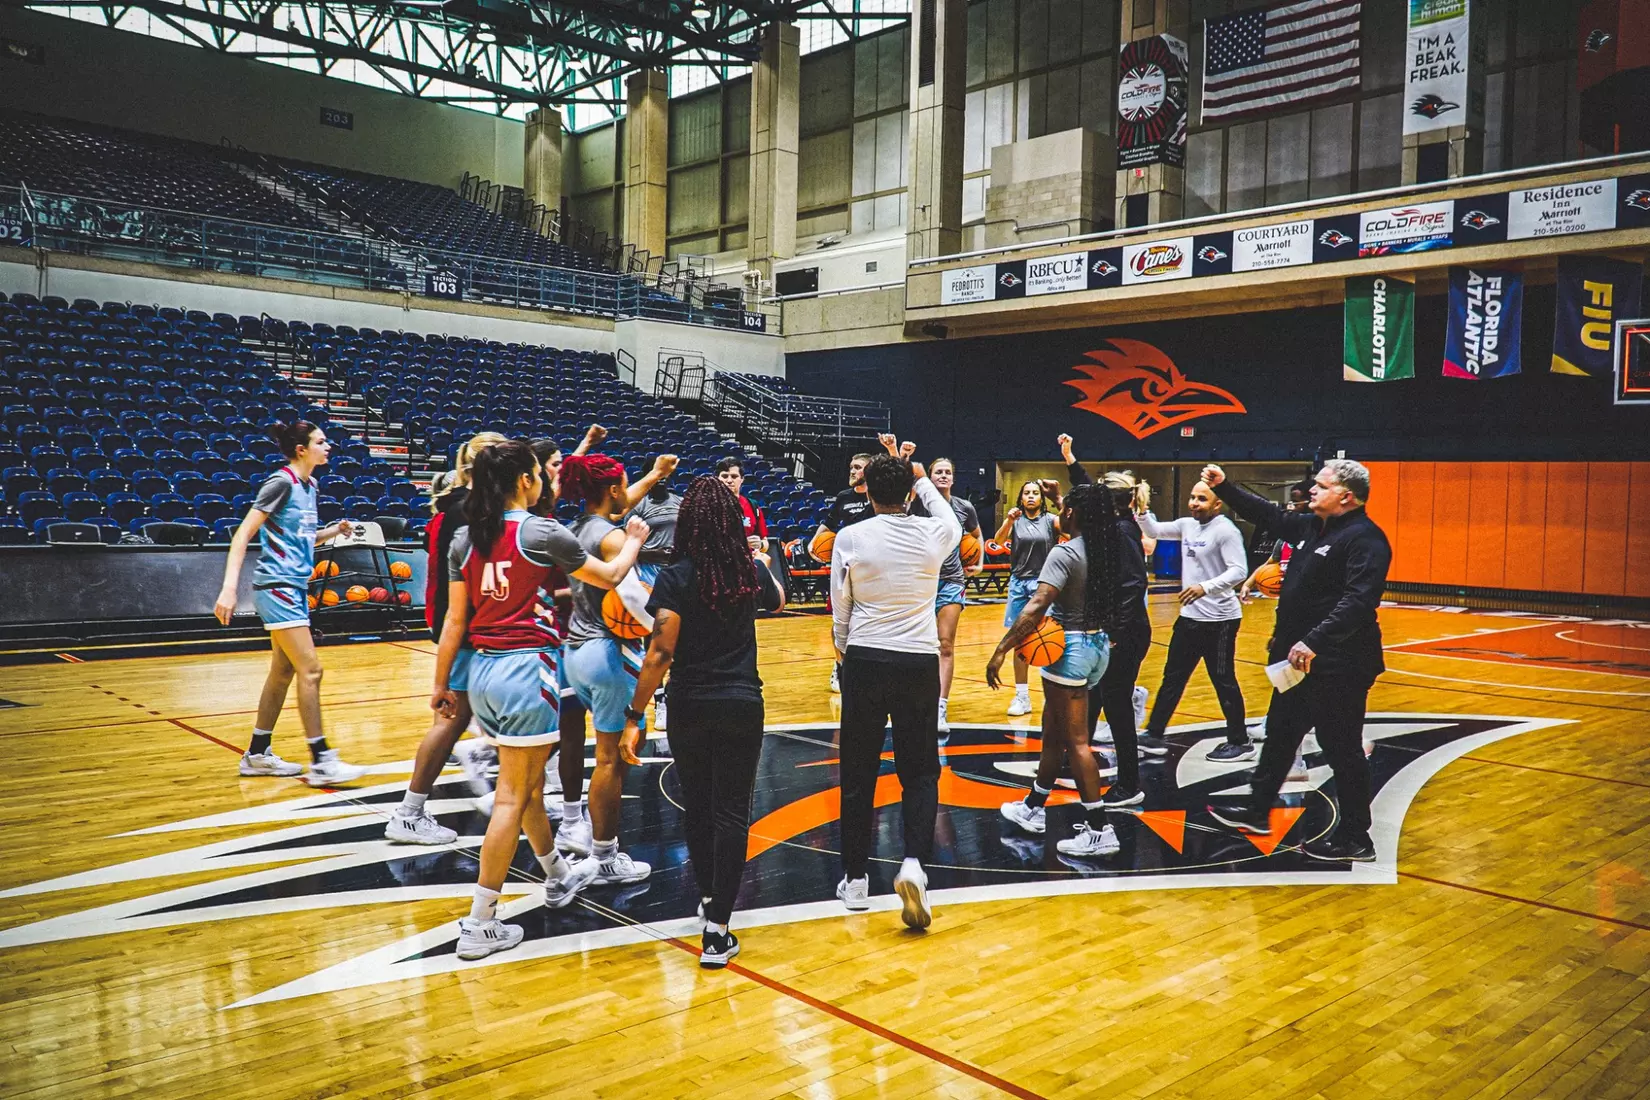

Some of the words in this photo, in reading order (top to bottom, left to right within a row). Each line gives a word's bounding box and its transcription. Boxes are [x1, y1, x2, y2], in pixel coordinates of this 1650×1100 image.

[1421, 3, 1461, 19] human
[1418, 34, 1440, 51] I'M
[1444, 32, 1455, 46] A
[1415, 46, 1456, 67] BEAK
[1410, 60, 1465, 83] FREAK.
[1121, 84, 1162, 100] COLDFIRE
[1523, 184, 1602, 203] Residence
[1538, 206, 1581, 221] Marriott
[1553, 200, 1570, 208] Inn
[1366, 211, 1446, 232] COLDFIRE
[1533, 224, 1586, 236] 210-561-0200
[1238, 223, 1309, 242] COURTYARD
[1253, 239, 1291, 254] Marriott
[1029, 260, 1073, 278] RBFCU
[1133, 244, 1182, 276] Cane's
[432, 275, 457, 283] SECTION
[432, 281, 457, 294] 103
[952, 278, 985, 292] PEDROTTI'S
[744, 316, 762, 328] 104
[1464, 270, 1484, 375] ATLANTIC
[1482, 277, 1502, 366] FLORIDA
[1580, 280, 1613, 351] FIU
[1372, 279, 1386, 379] CHARLOTTE
[480, 560, 512, 601] 45
